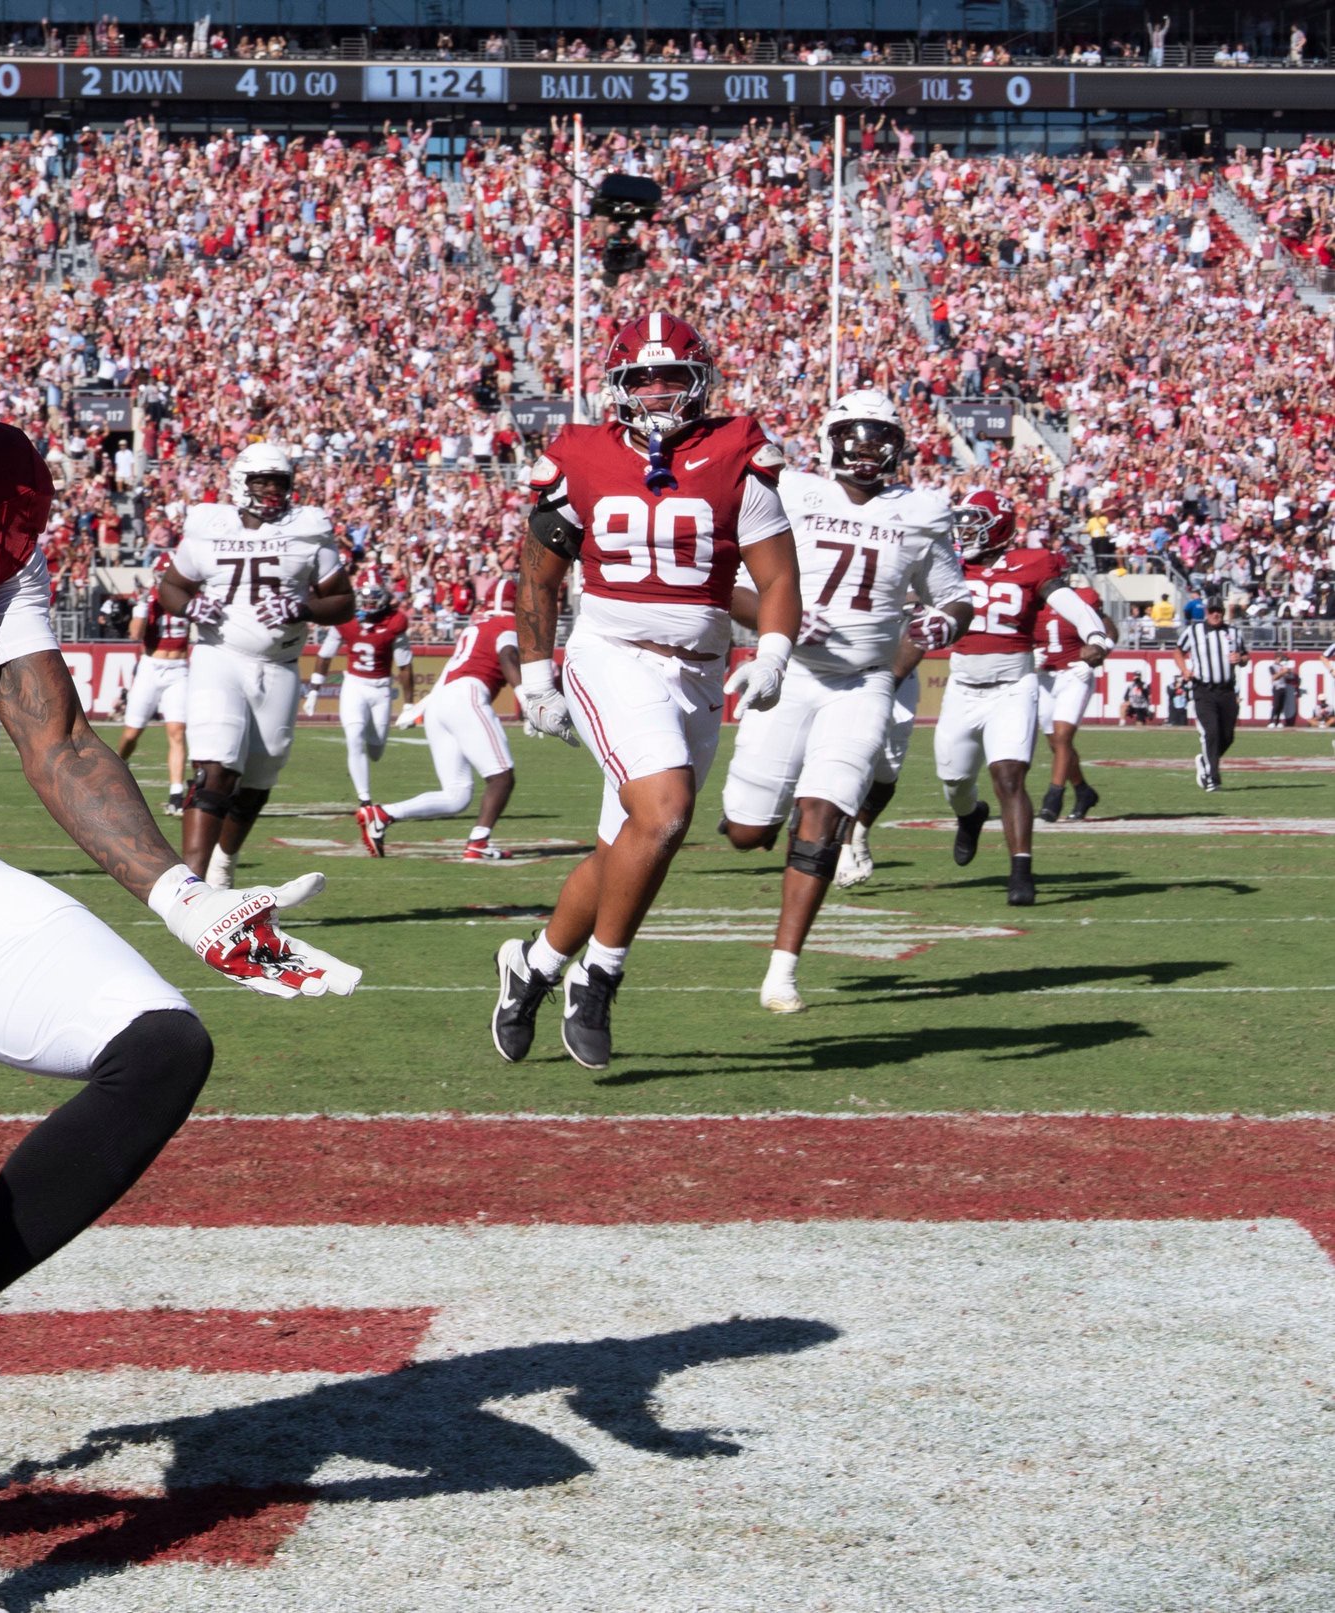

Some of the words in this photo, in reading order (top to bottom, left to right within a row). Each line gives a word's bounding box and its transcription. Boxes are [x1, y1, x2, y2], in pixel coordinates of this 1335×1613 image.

[81, 66, 102, 96] 2
[111, 69, 183, 95] DOWN
[235, 68, 259, 97] 4
[266, 71, 297, 96] TO
[304, 71, 337, 96] GO
[386, 69, 487, 98] 11:24
[540, 75, 597, 100] BALL
[602, 75, 634, 100] ON
[647, 72, 690, 102] 35
[724, 75, 770, 103] QTR
[782, 73, 796, 103] 1
[919, 78, 954, 101] TOL
[957, 79, 974, 101] 3
[1006, 76, 1032, 106] 0
[105, 410, 125, 422] 117
[986, 416, 1006, 429] 119
[592, 495, 714, 586] 90
[804, 515, 863, 537] TEXAS
[869, 525, 905, 545] A&M
[213, 539, 254, 552] TEXAS
[260, 539, 288, 553] A&M
[217, 556, 281, 606] 76
[813, 540, 880, 612] 71
[351, 642, 376, 672] 3
[212, 895, 271, 936] CRIMSON
